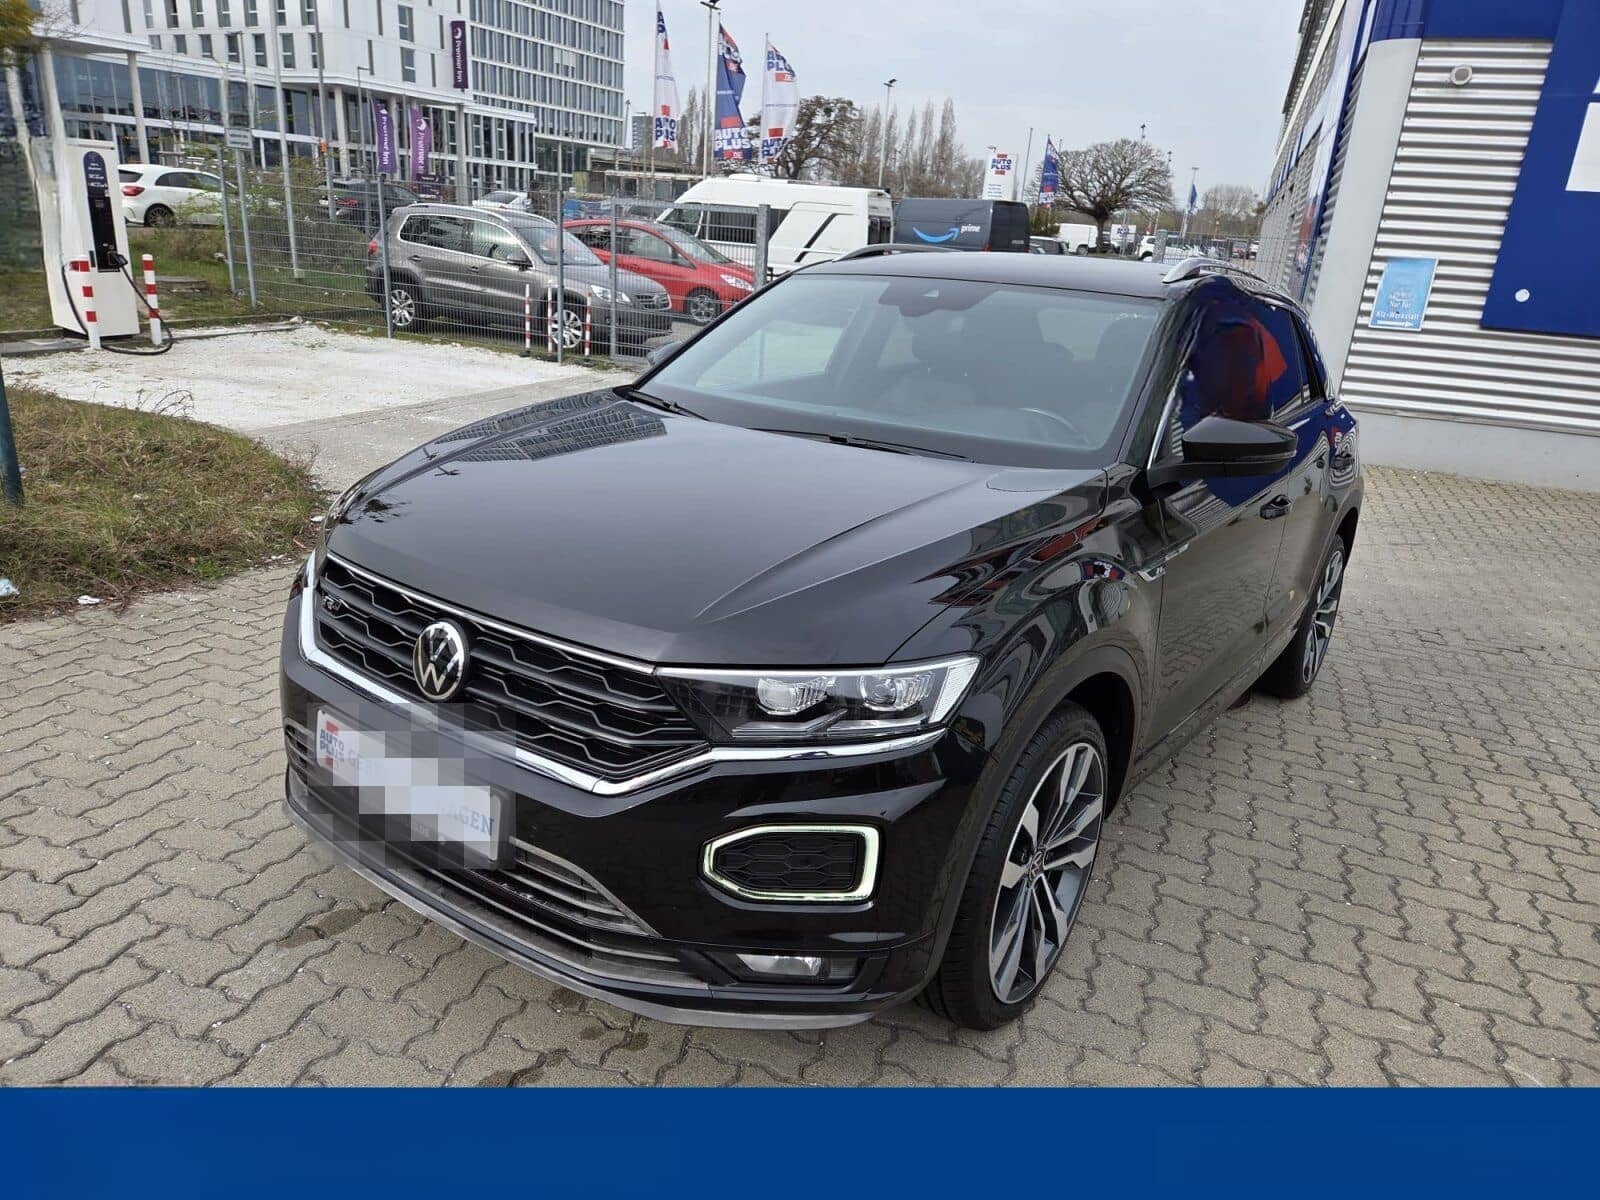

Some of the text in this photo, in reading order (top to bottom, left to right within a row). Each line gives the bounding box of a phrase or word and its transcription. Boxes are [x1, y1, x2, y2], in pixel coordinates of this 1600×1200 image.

[382, 115, 391, 165] Premier Inn
[715, 127, 749, 139] AUTO
[416, 132, 426, 164] Premier
[714, 138, 751, 151] PLUS
[960, 223, 981, 234] prime
[319, 729, 345, 752] AUTO
